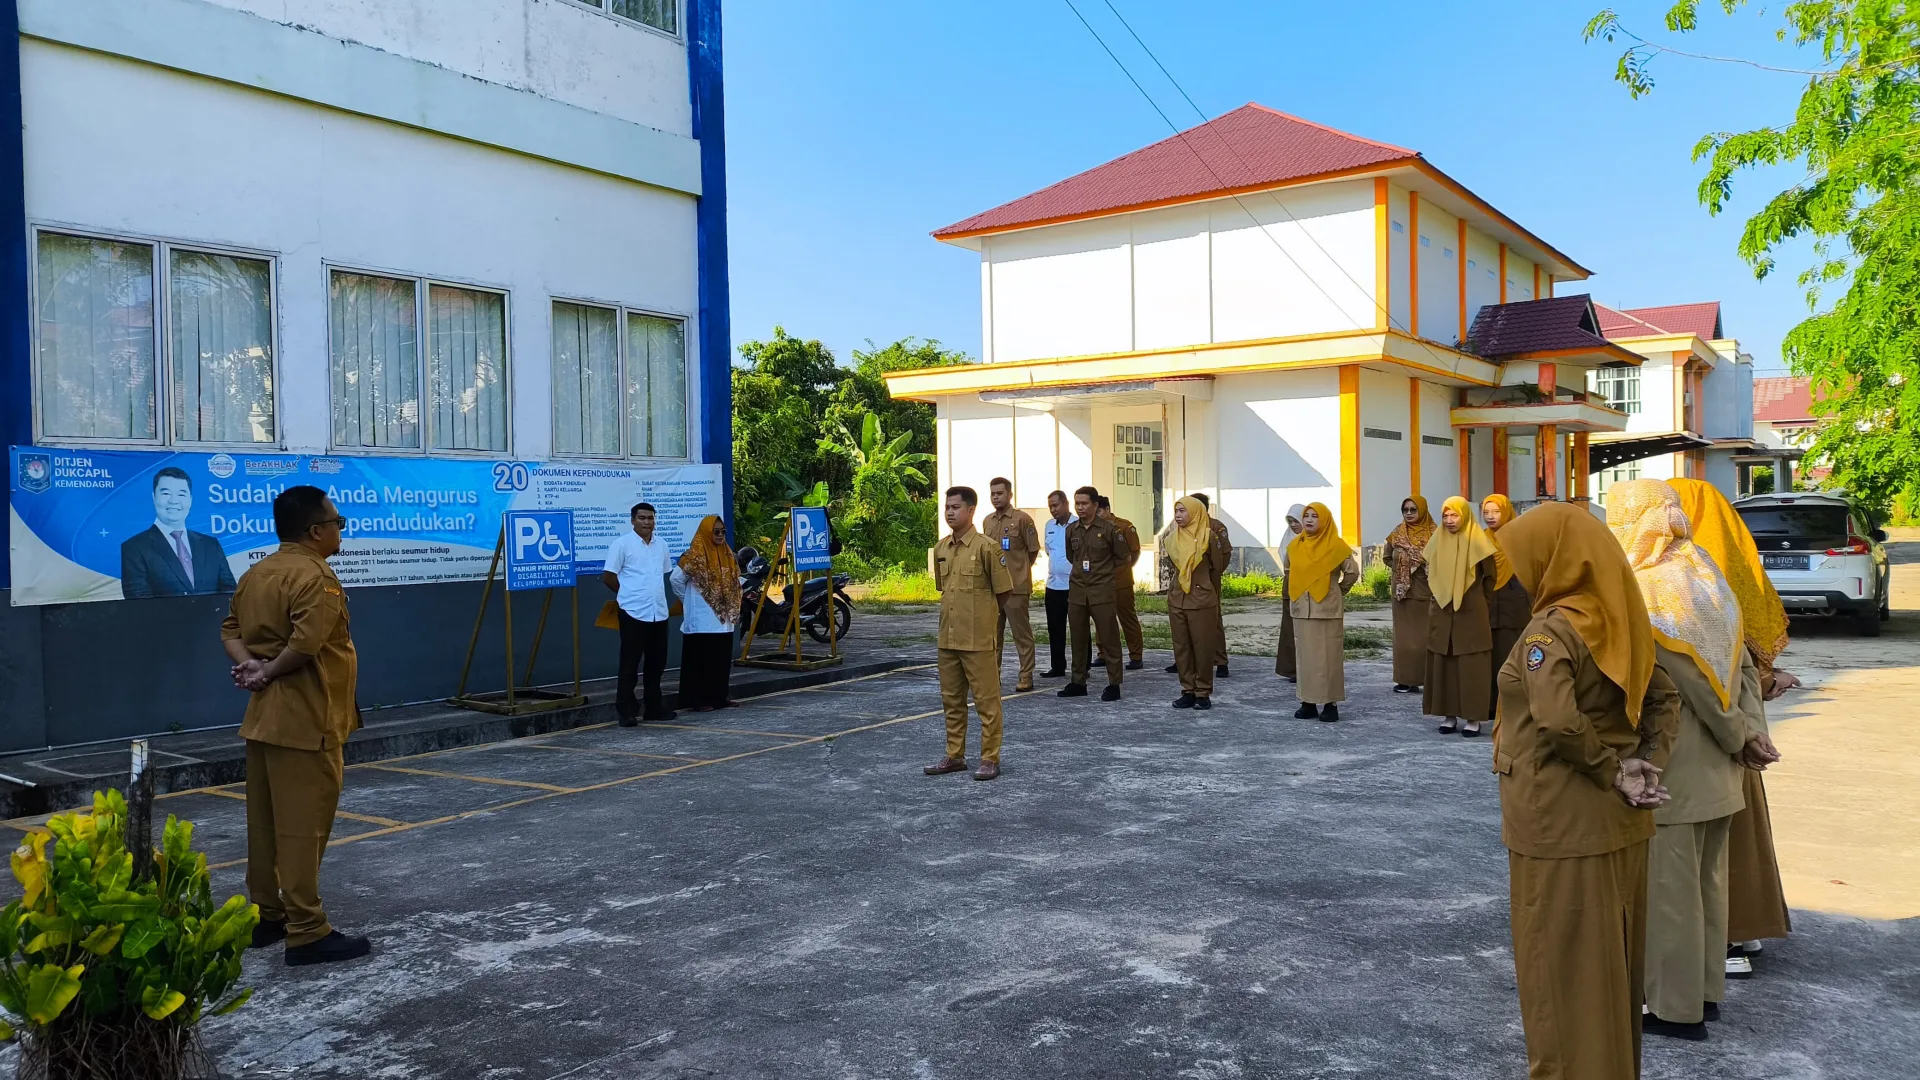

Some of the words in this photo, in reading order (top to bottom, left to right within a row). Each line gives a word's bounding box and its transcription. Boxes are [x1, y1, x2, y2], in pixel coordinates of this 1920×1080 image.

[54, 457, 92, 467] DITJEN
[245, 460, 298, 468] BerAKHLAK
[54, 468, 112, 478] DUKCAPIL
[494, 463, 528, 491] 20
[532, 468, 571, 477] DOKUMEN
[572, 470, 631, 478] KEPENDUDUKAN
[55, 480, 114, 488] KEMENDAGRI
[327, 485, 378, 503] Anda
[384, 486, 477, 508] Mengurus
[342, 512, 476, 536] pendudukan?
[796, 514, 810, 548] P
[514, 518, 540, 560] P
[430, 546, 450, 554] hidup
